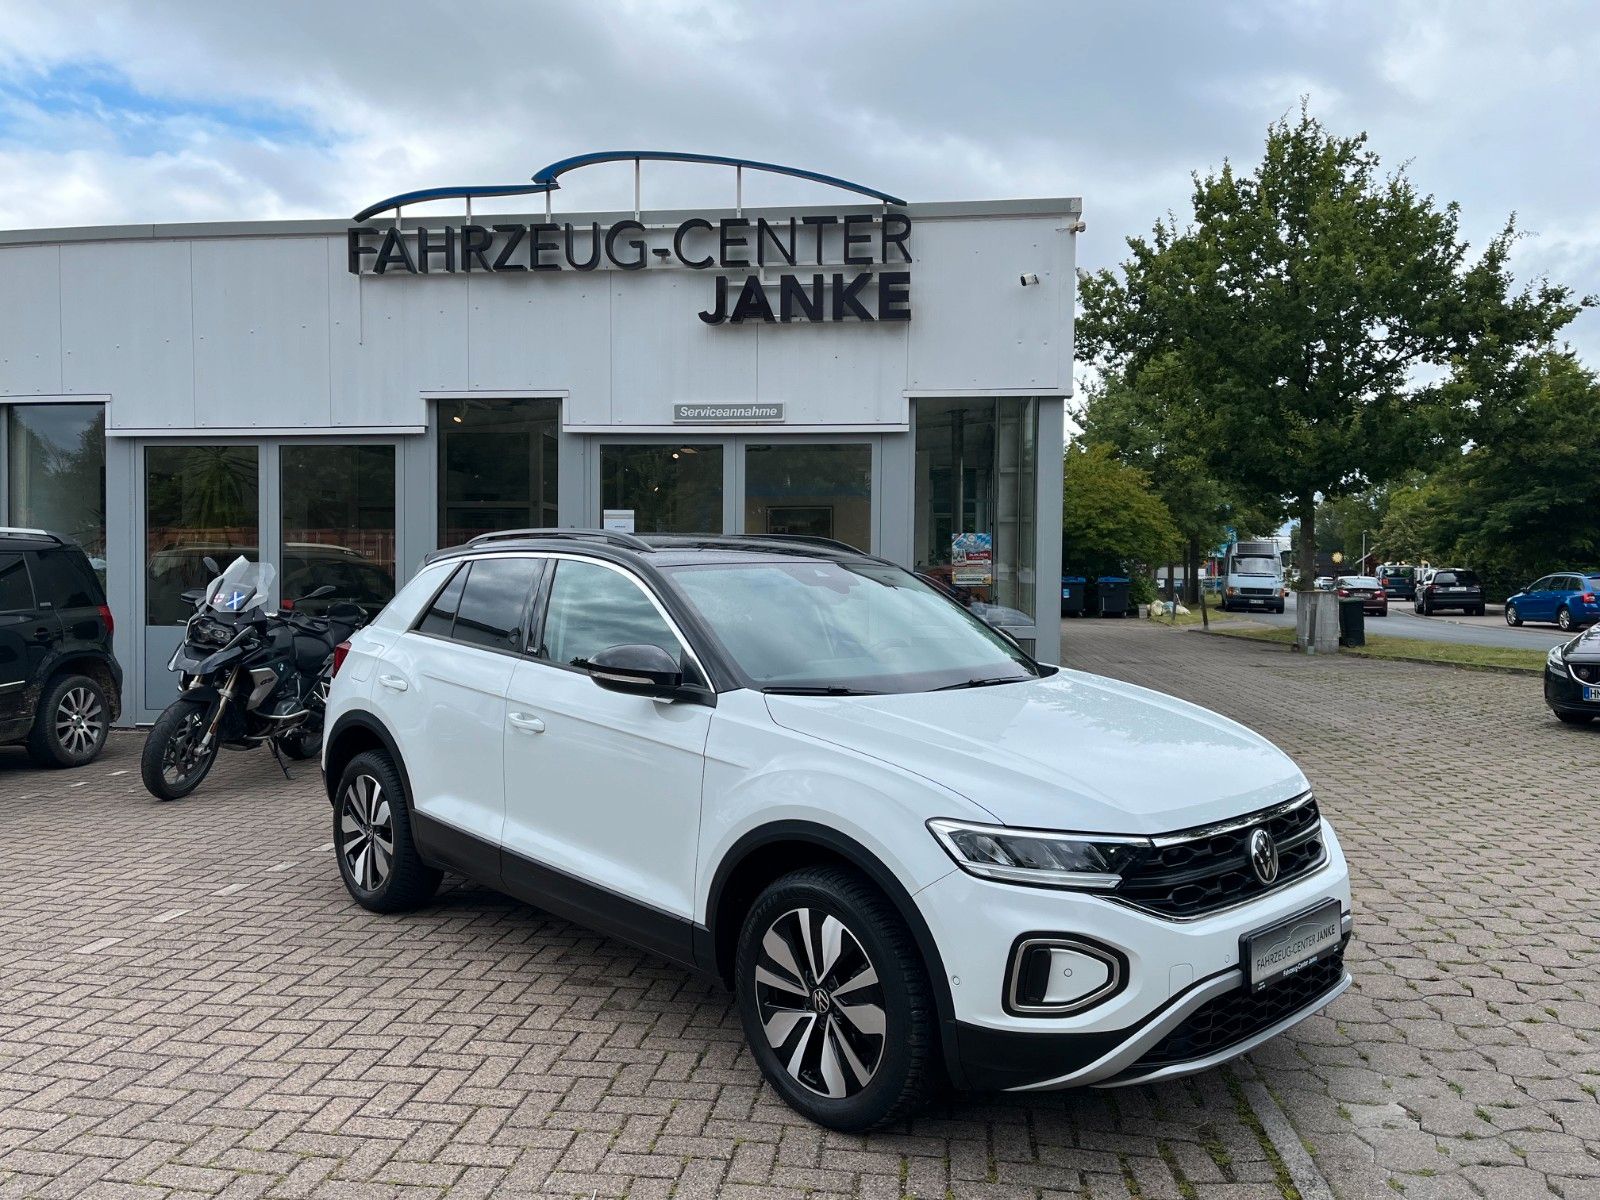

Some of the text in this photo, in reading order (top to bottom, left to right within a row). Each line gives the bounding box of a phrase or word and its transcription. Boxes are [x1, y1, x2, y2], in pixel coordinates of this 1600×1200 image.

[348, 214, 912, 275] FAHRZEUG-CENTER
[698, 271, 911, 326] JANKE
[679, 406, 778, 418] Serviceannahme
[1256, 923, 1336, 972] FAHRZEUG-CENTER JANKE
